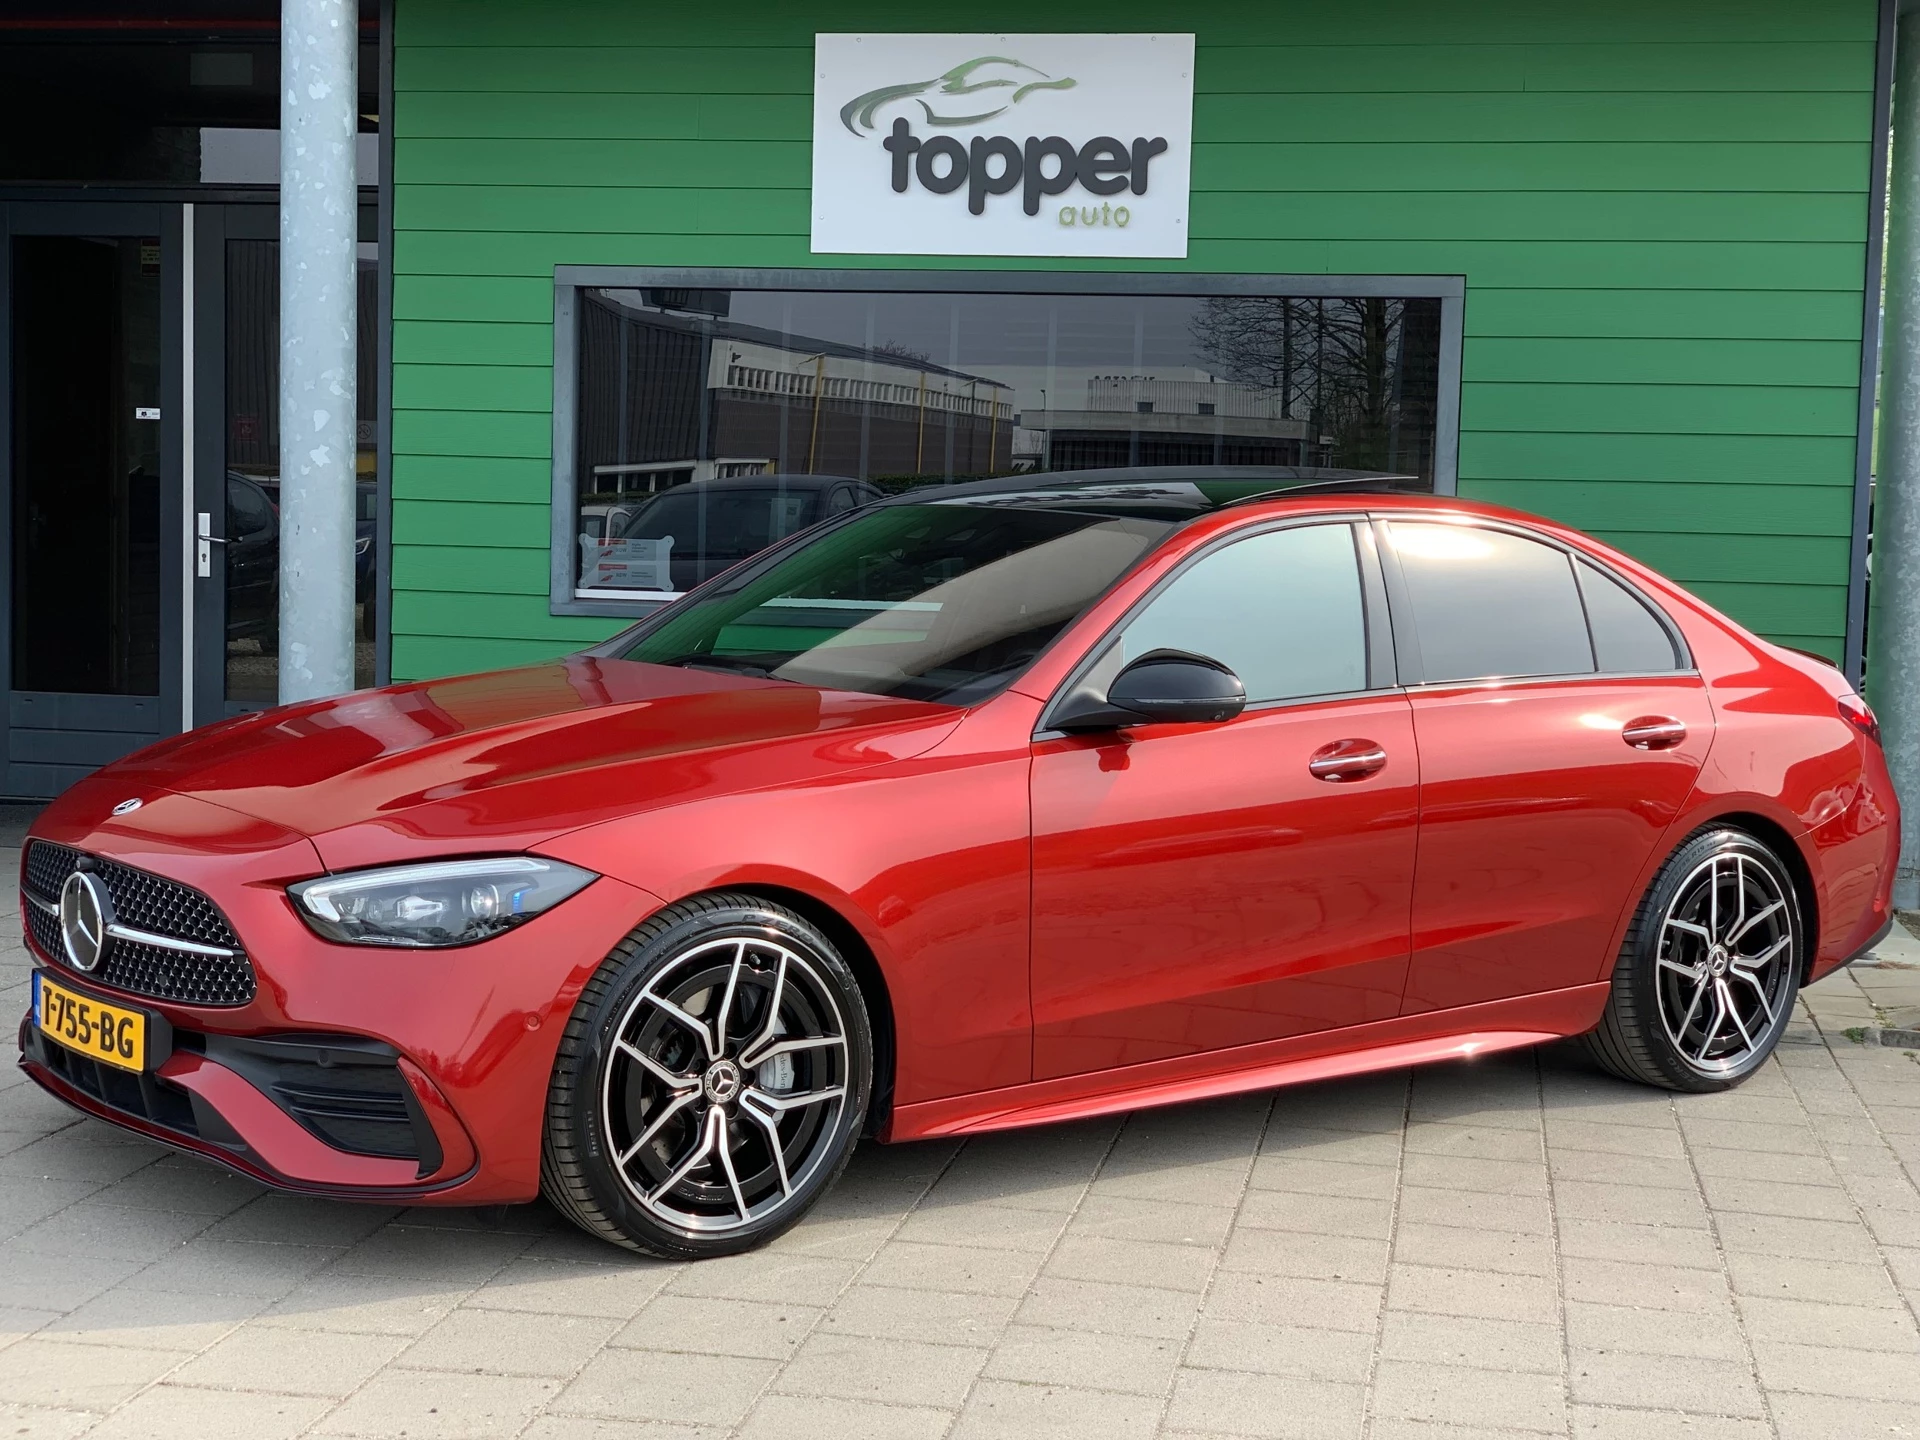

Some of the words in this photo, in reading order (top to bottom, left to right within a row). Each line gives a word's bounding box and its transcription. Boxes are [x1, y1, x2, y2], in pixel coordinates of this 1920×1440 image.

[882, 116, 1168, 216] topper
[1058, 201, 1130, 228] auto
[42, 984, 134, 1060] T-755-BG
